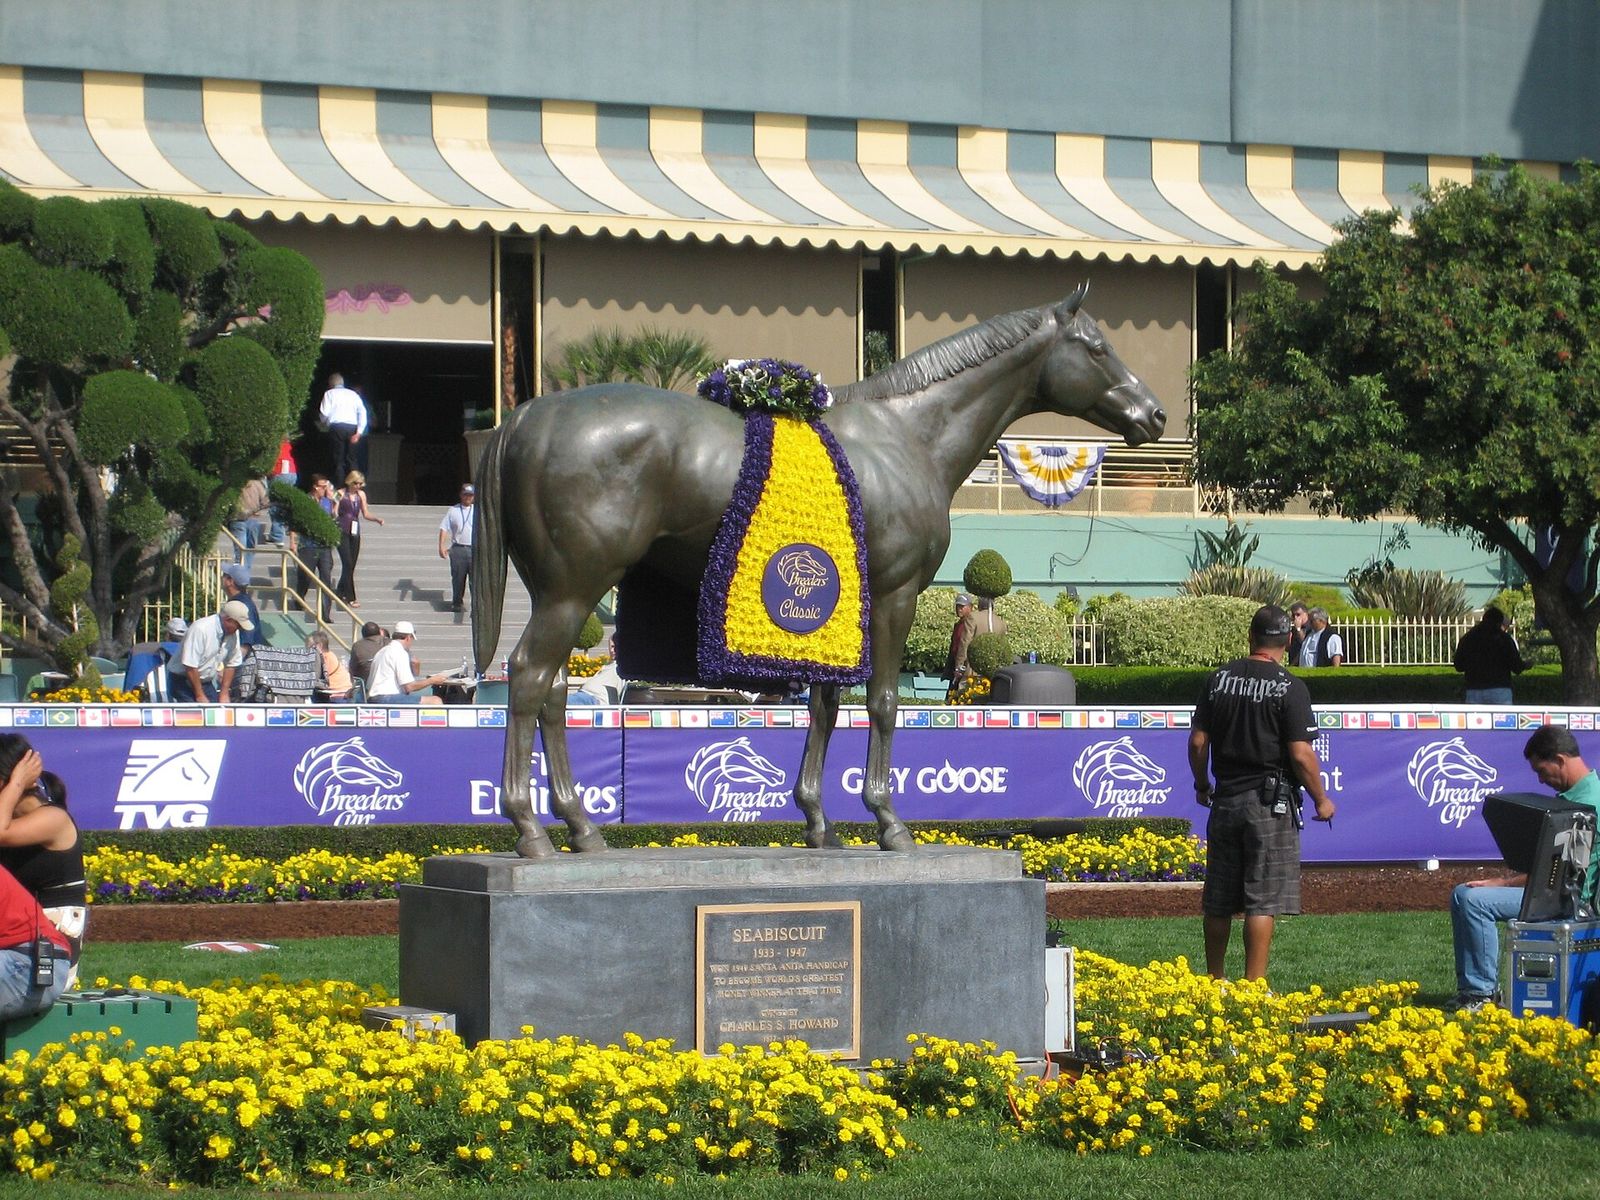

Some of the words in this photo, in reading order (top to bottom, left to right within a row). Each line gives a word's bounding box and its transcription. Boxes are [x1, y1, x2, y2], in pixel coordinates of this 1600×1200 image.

[794, 586, 814, 600] Cup
[779, 598, 821, 619] Classic
[841, 767, 911, 794] GY
[916, 759, 1007, 794] GOOSE
[317, 783, 411, 816] Breeders'
[707, 782, 793, 813] Breeders'
[1093, 779, 1173, 809] Breeders'
[113, 803, 209, 830] TVG
[1440, 801, 1471, 829] Cup
[733, 926, 827, 943] SEABISCUIT
[753, 948, 775, 959] 1933
[786, 946, 807, 958] 1947
[750, 962, 778, 972] SANTA
[780, 961, 805, 971] ANITA
[806, 960, 849, 970] HANDICAP
[802, 973, 845, 983] GREATEST
[719, 1020, 773, 1033] CHARLES
[788, 1017, 839, 1030] HOWARD
